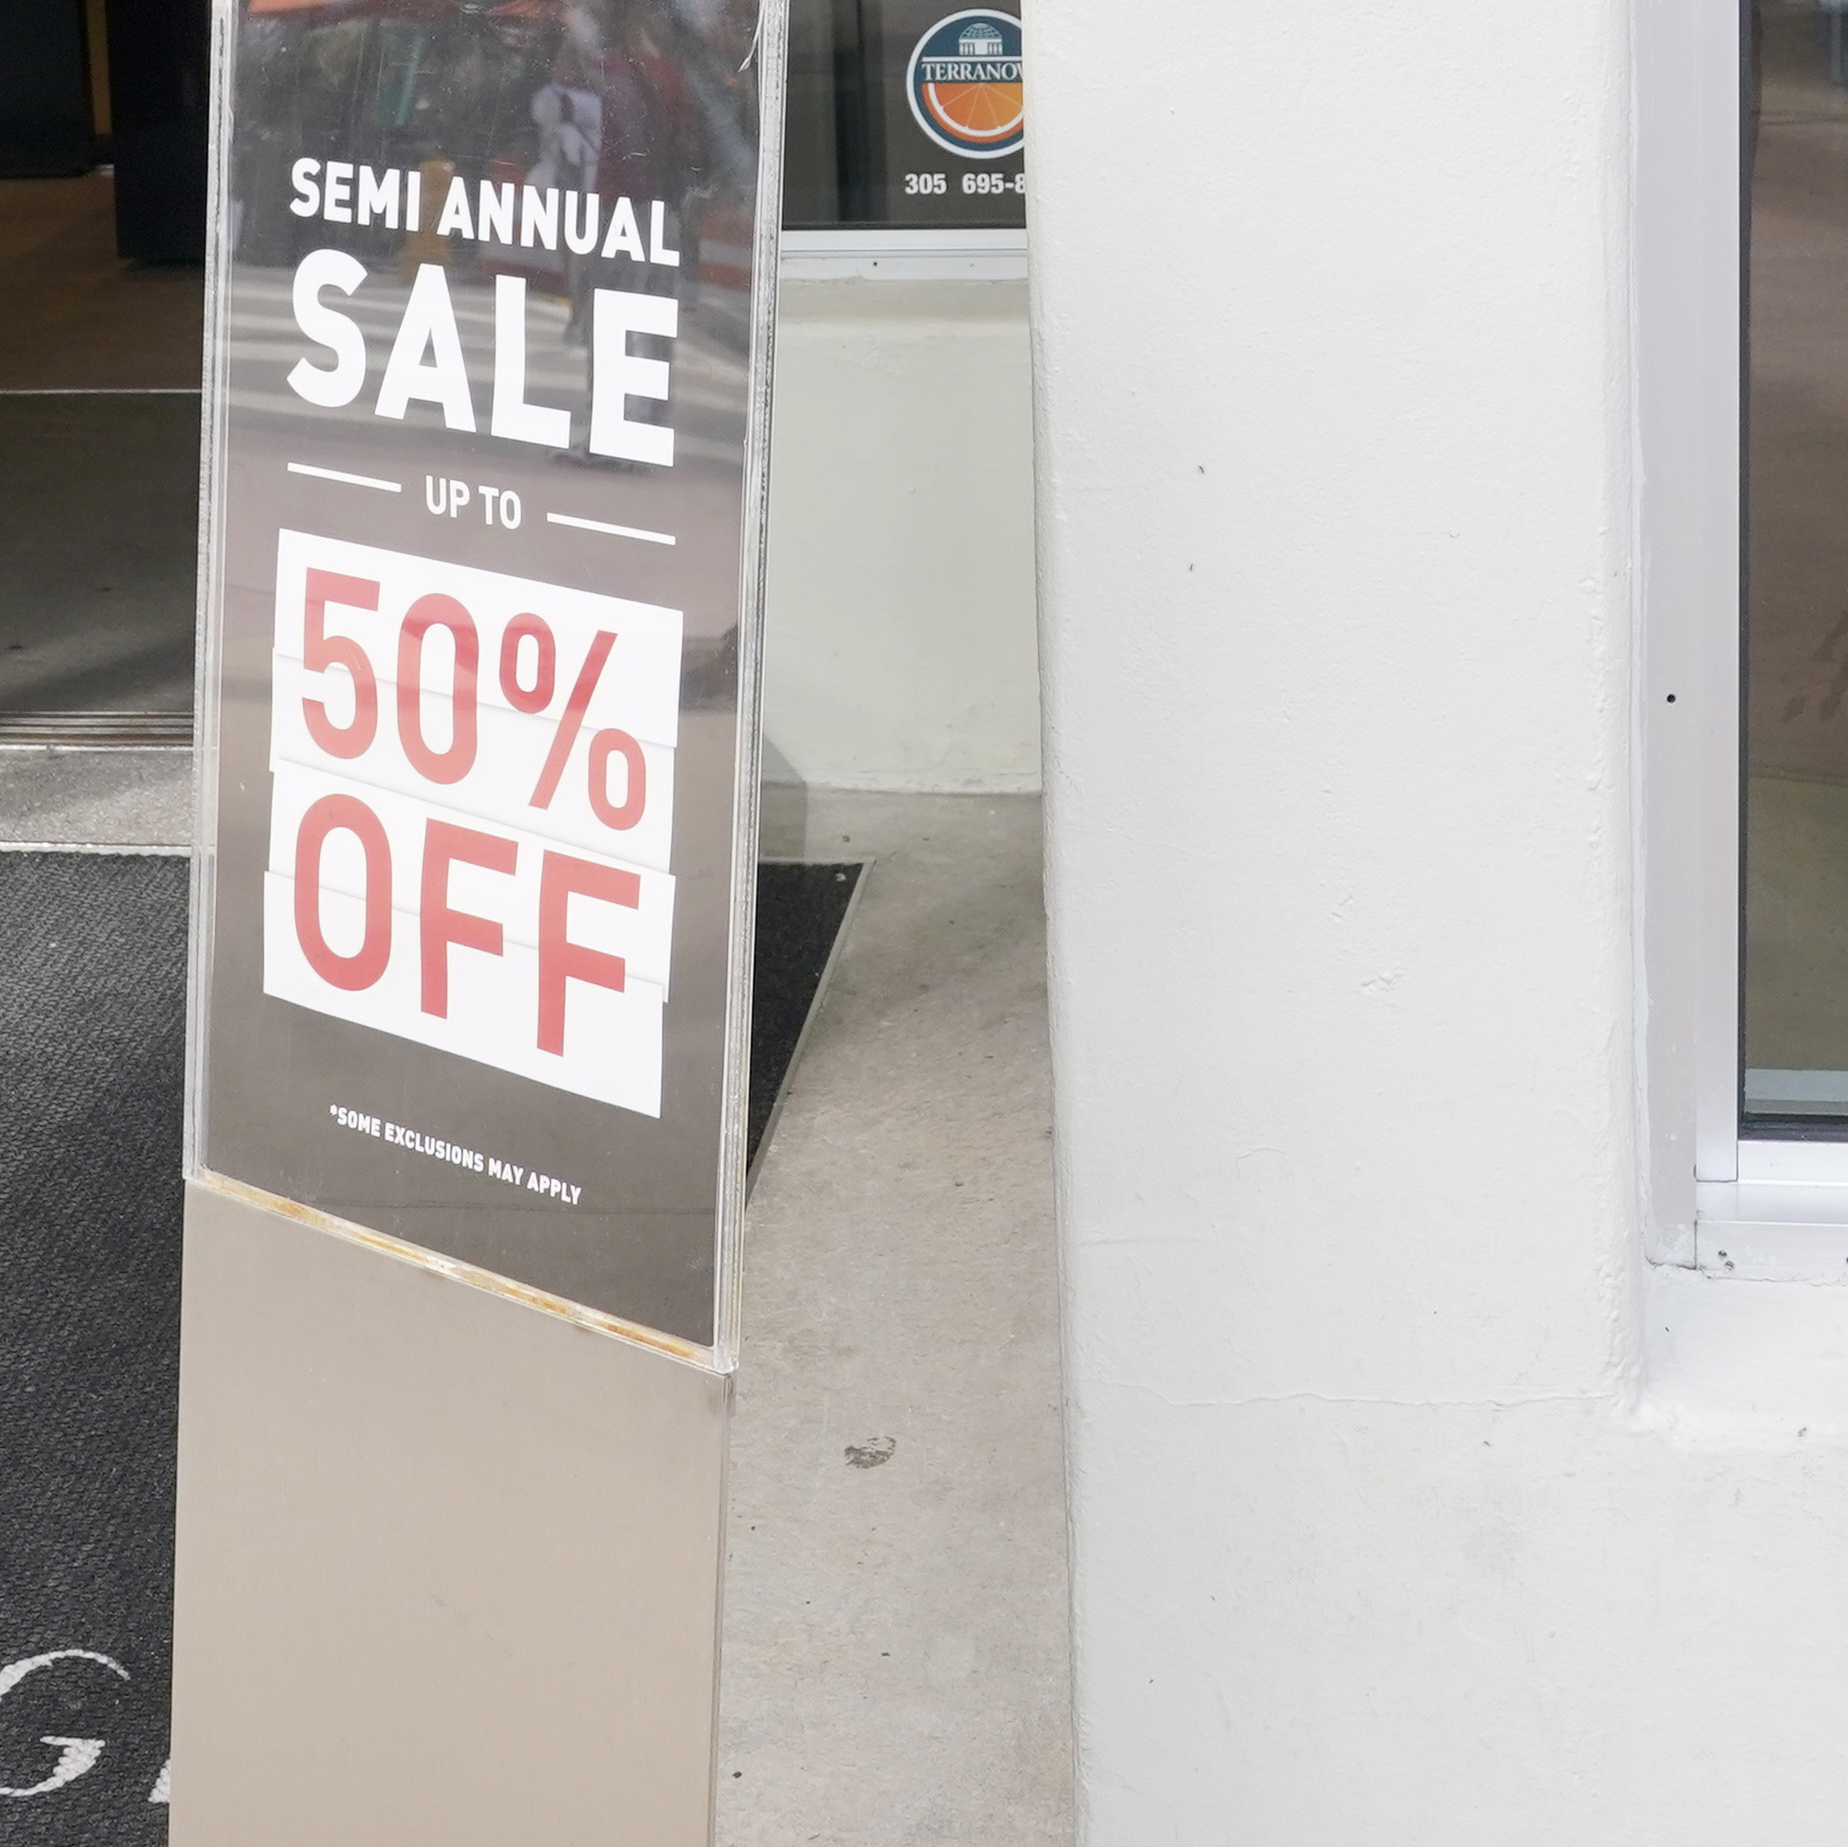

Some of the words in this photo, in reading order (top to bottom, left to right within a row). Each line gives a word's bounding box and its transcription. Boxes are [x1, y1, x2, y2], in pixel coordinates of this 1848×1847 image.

[289, 157, 422, 232] SEMI
[436, 176, 681, 268] ANNUAL
[904, 173, 948, 195] 305
[285, 248, 680, 468] SALE
[424, 475, 470, 519] UP
[478, 485, 522, 530] TO
[300, 566, 647, 832] 50%
[293, 792, 642, 1059] OFF
[384, 1121, 485, 1173] EXCLUSIONS
[487, 1156, 525, 1186] MAY
[526, 1170, 583, 1206] APPLY
